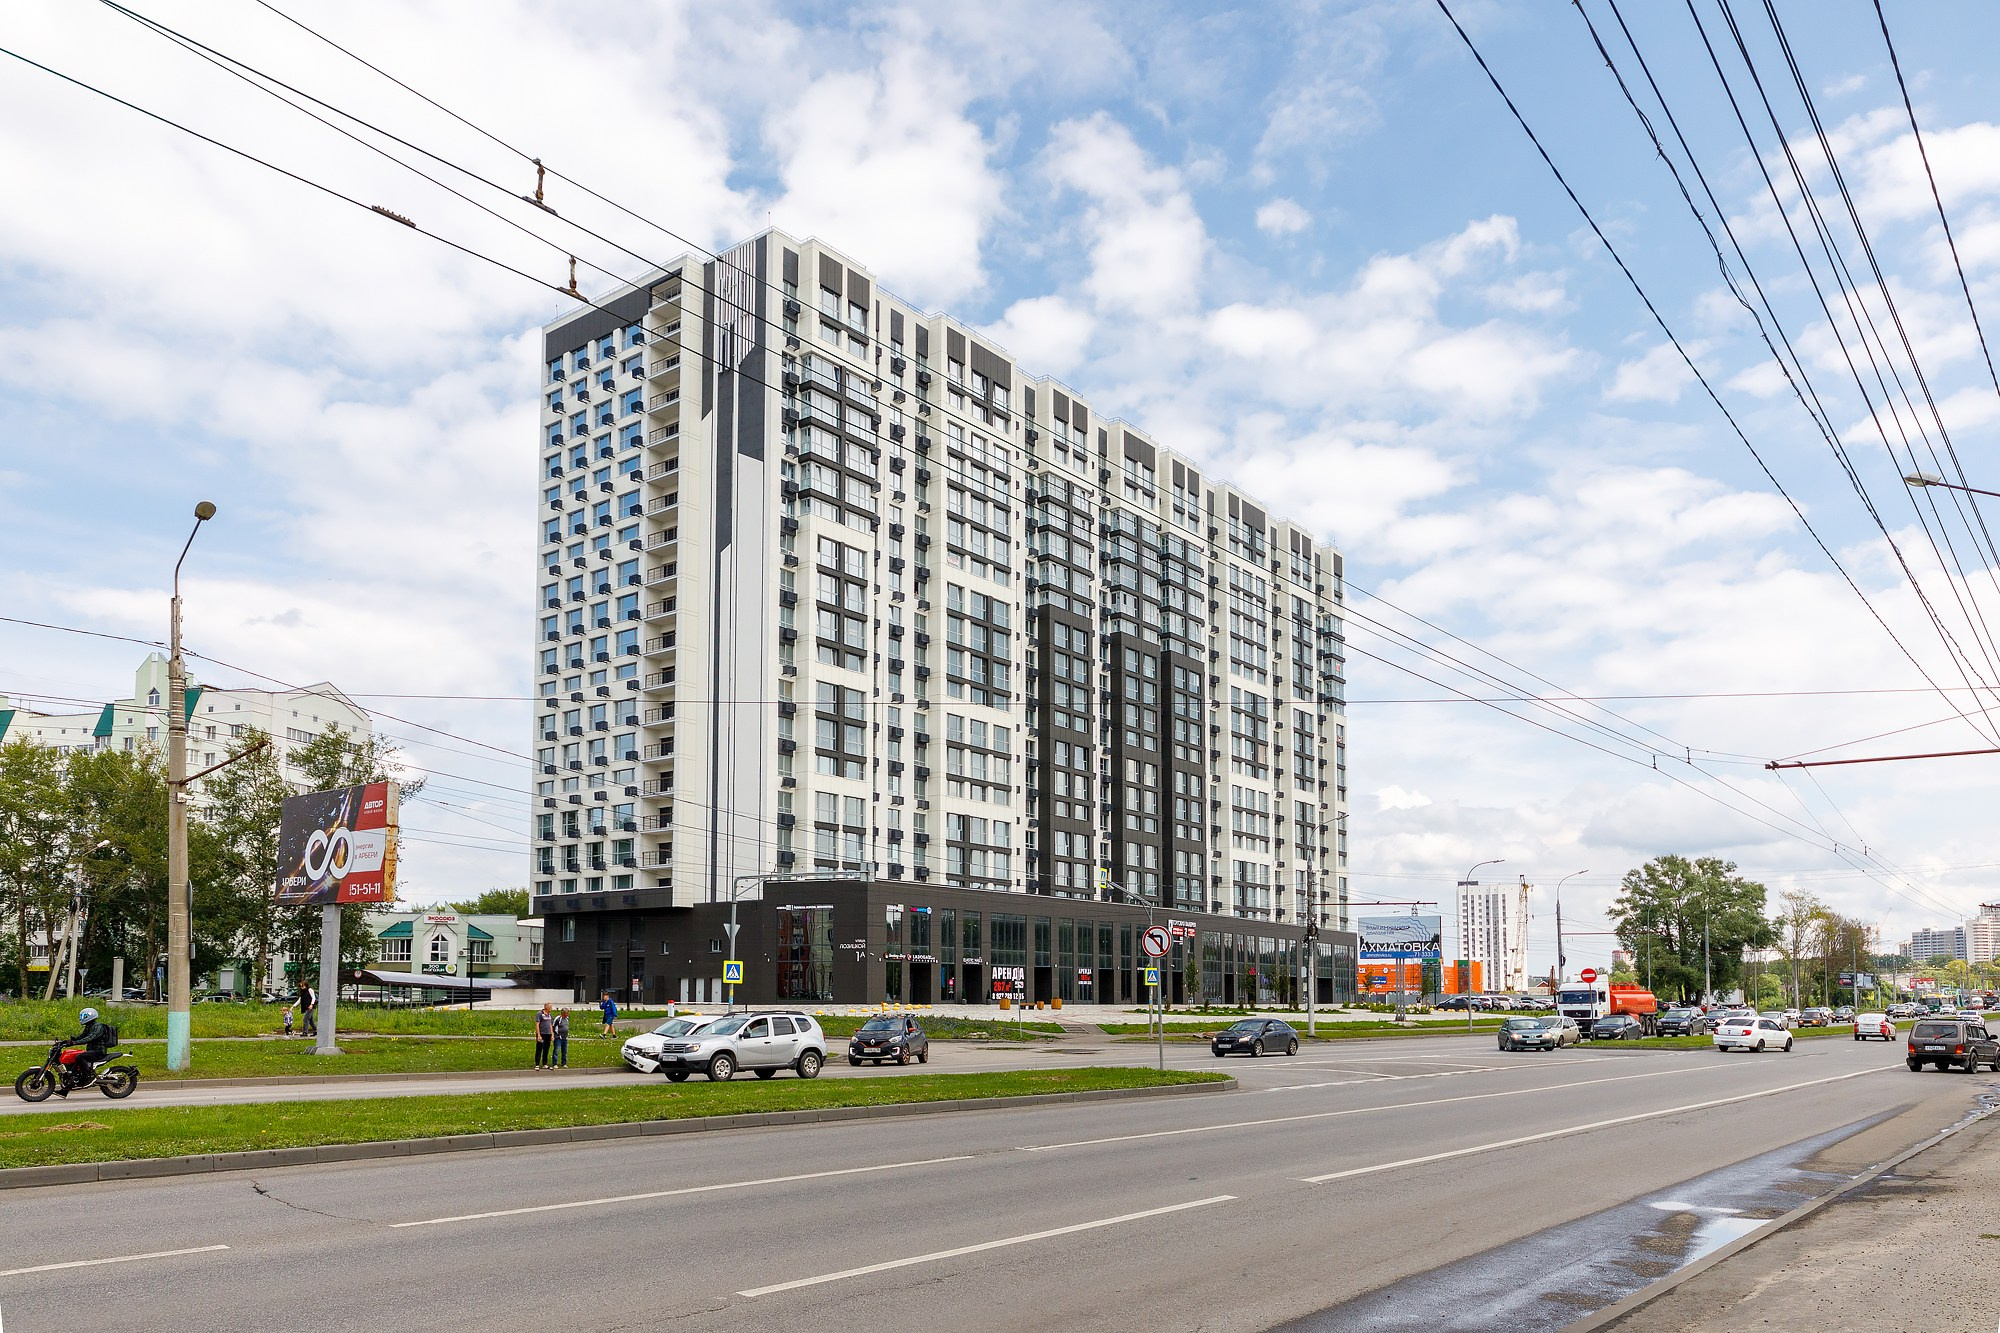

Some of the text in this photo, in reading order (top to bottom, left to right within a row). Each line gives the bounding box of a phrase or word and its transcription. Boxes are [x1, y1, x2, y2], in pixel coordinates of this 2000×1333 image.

[364, 800, 383, 809] АВТОР
[359, 851, 378, 860] АРБЕРИ
[351, 883, 380, 895] 51-51-11
[1360, 942, 1440, 952] АХМАТОВКА
[992, 967, 1024, 981] АРЕНДА
